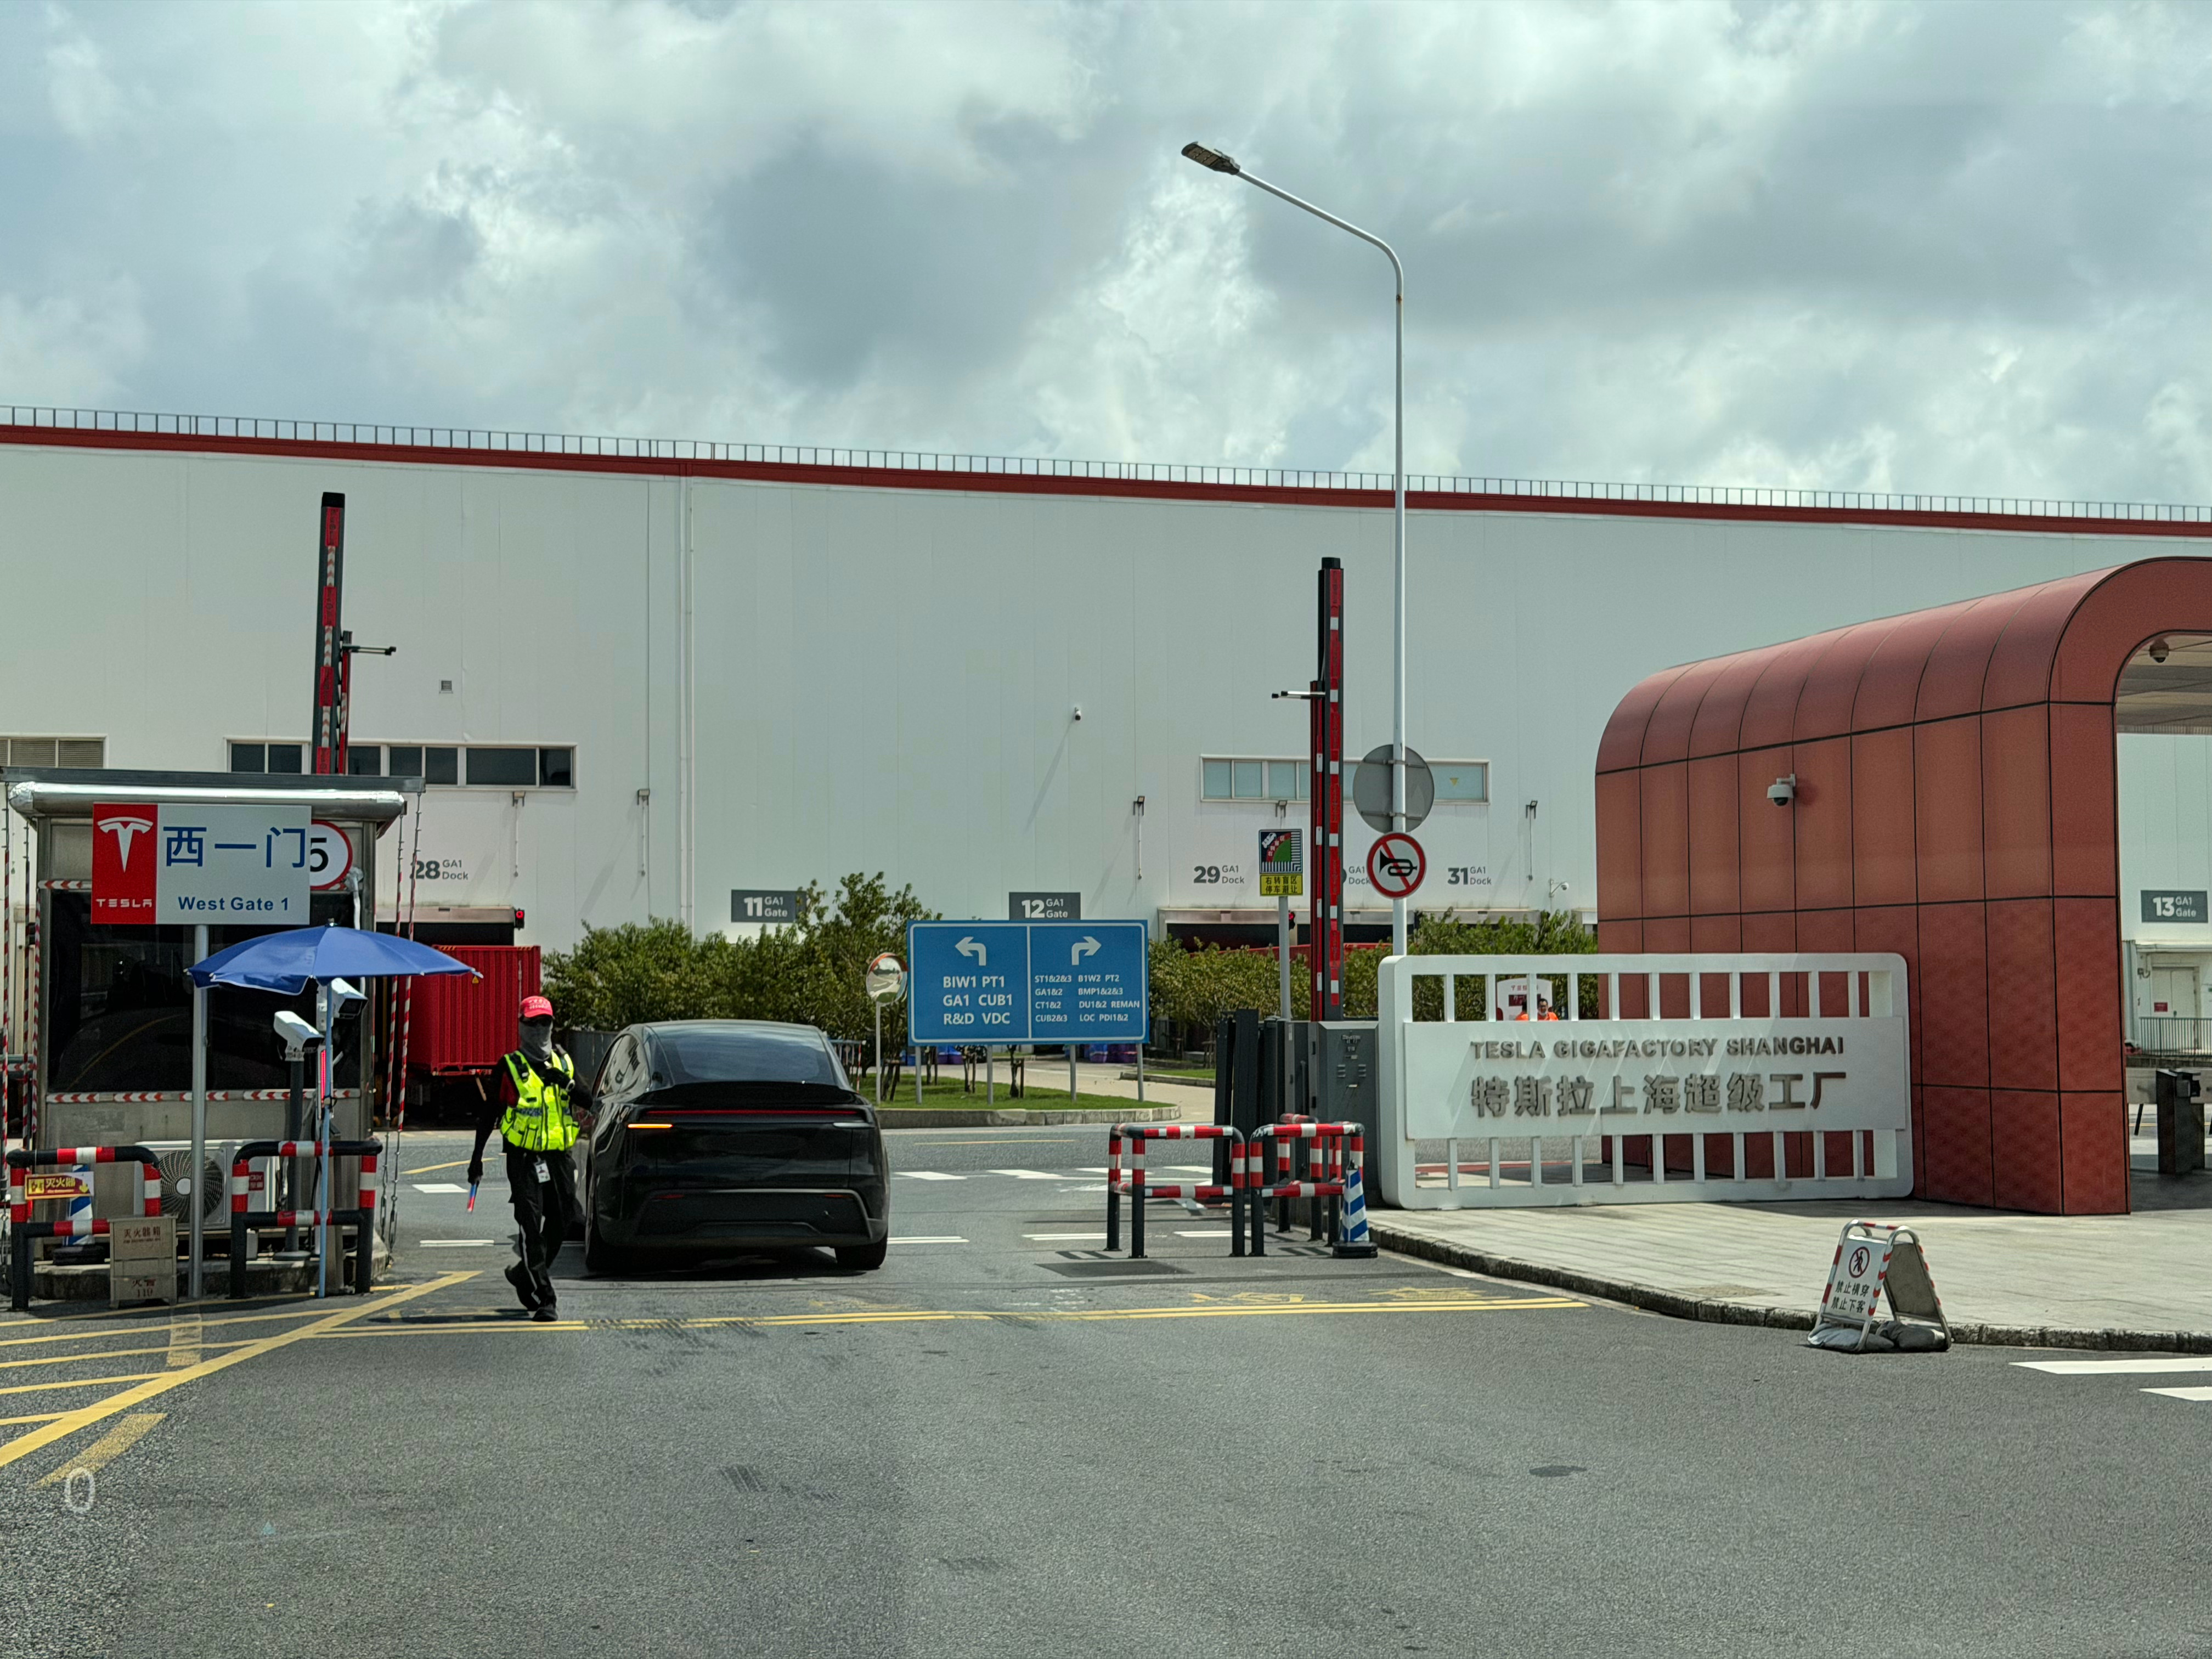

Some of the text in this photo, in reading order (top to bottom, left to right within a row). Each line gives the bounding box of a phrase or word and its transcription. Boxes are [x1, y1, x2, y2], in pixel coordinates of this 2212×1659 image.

[163, 826, 307, 868] 西一门
[410, 860, 441, 879] 28
[442, 860, 462, 868] GA1
[1222, 865, 1239, 873] GA1
[442, 871, 469, 880] Dock
[1193, 866, 1221, 884] 29
[1348, 866, 1365, 874] GA1
[1470, 866, 1486, 874] GA1
[1222, 875, 1245, 884] Dock
[1448, 867, 1469, 885] 31
[1470, 876, 1492, 885] Dock
[97, 899, 152, 909] TESLA
[178, 896, 289, 911] West Gate 1
[765, 896, 783, 905] GA1
[1046, 899, 1064, 907] GA1
[2175, 896, 2192, 906] GA1
[744, 897, 763, 917] 11
[1022, 900, 1045, 918] 12
[2153, 896, 2175, 917] 13
[2176, 907, 2197, 917] Gate
[765, 908, 788, 917] Gate
[1046, 910, 1068, 919] Gate
[943, 975, 1005, 988] BIW1 PT1
[943, 994, 1012, 1006] GA1 CUB1
[944, 1012, 1010, 1025] R&D VDC
[1471, 1036, 1844, 1059] TESLA GIGAFACTORY SHANGHAI
[1471, 1071, 1847, 1118] 特斯拉上海超级工厂
[1831, 1296, 1866, 1313] 禁止下客
